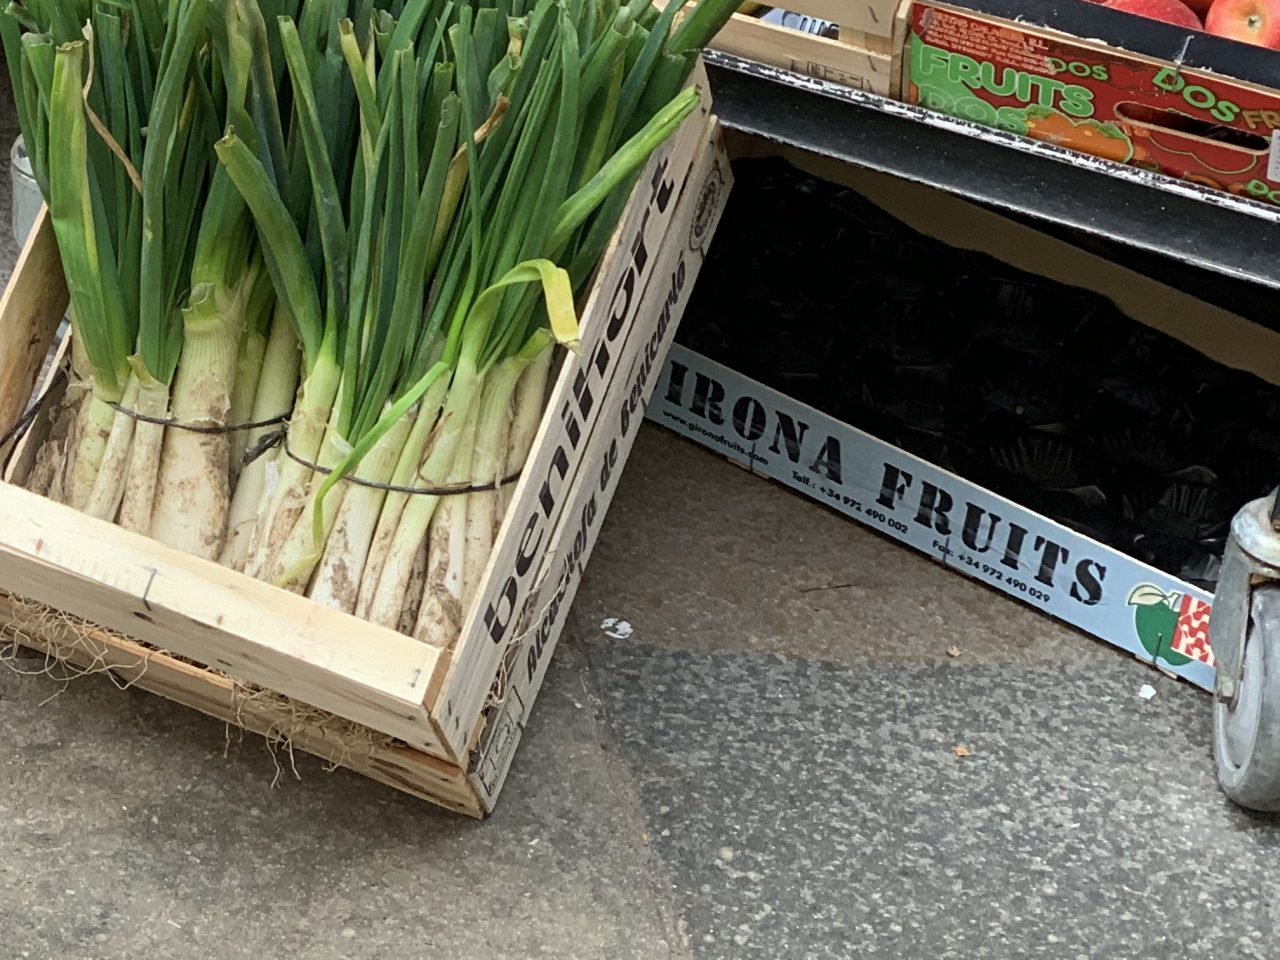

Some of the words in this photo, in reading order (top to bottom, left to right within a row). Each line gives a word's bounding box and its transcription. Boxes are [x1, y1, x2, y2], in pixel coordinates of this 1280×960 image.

[920, 44, 1095, 117] FRUITS
[1152, 66, 1241, 123] DOS
[483, 157, 675, 645] benihort
[600, 438, 619, 493] de
[663, 360, 844, 486] IRONA
[875, 462, 1108, 606] FRUITS
[887, 517, 909, 535] 002
[981, 564, 1004, 582] 972
[1005, 576, 1027, 593] 490
[1028, 586, 1051, 603] 029
